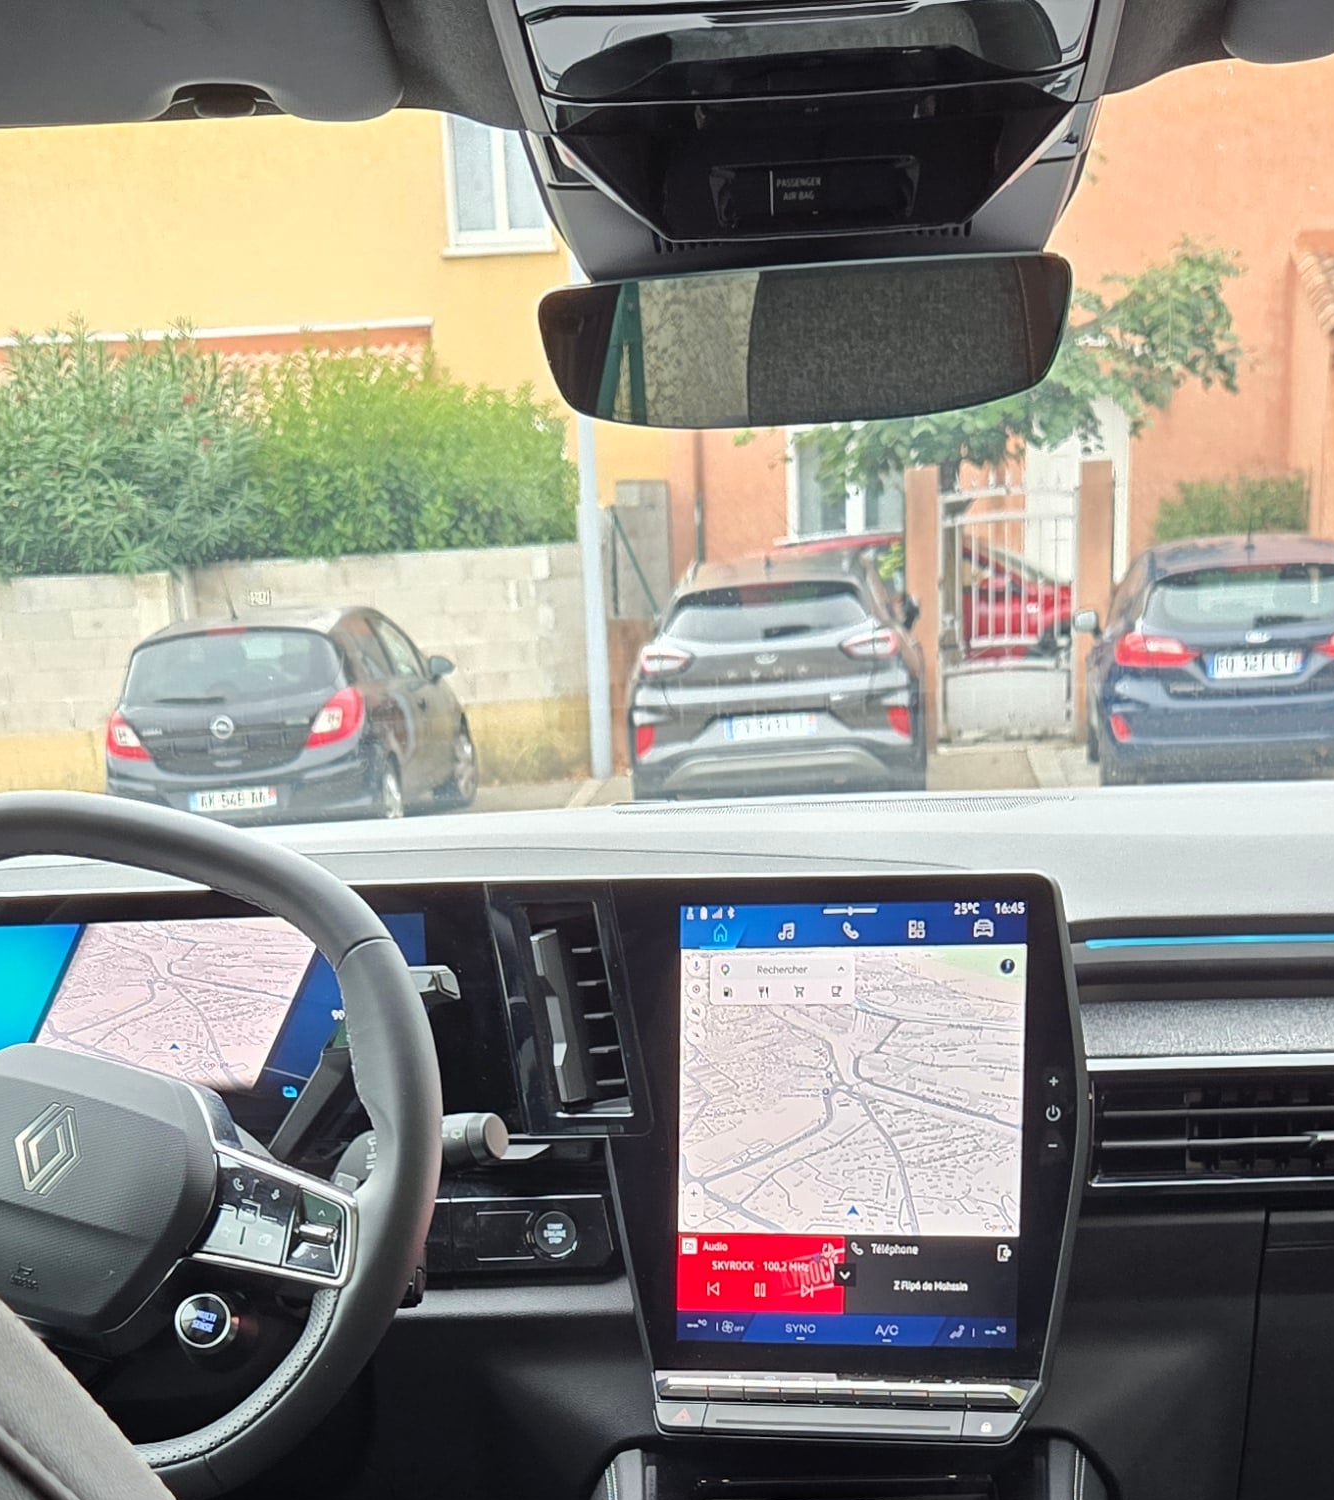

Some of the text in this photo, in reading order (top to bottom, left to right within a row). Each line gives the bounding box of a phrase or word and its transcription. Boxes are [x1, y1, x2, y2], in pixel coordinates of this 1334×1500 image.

[776, 176, 821, 188] PASSENGER
[783, 190, 815, 200] AIR BAG
[954, 901, 1025, 915] 25°C 16:45
[756, 965, 808, 974] Rechercher
[702, 1241, 728, 1252] Audio
[870, 1243, 919, 1256] Téléphone
[711, 1260, 755, 1271] SKYROCK
[788, 1262, 810, 1273] MHz
[922, 1280, 933, 1291] de
[785, 1323, 817, 1333] SYNC
[874, 1324, 899, 1336] A/C
